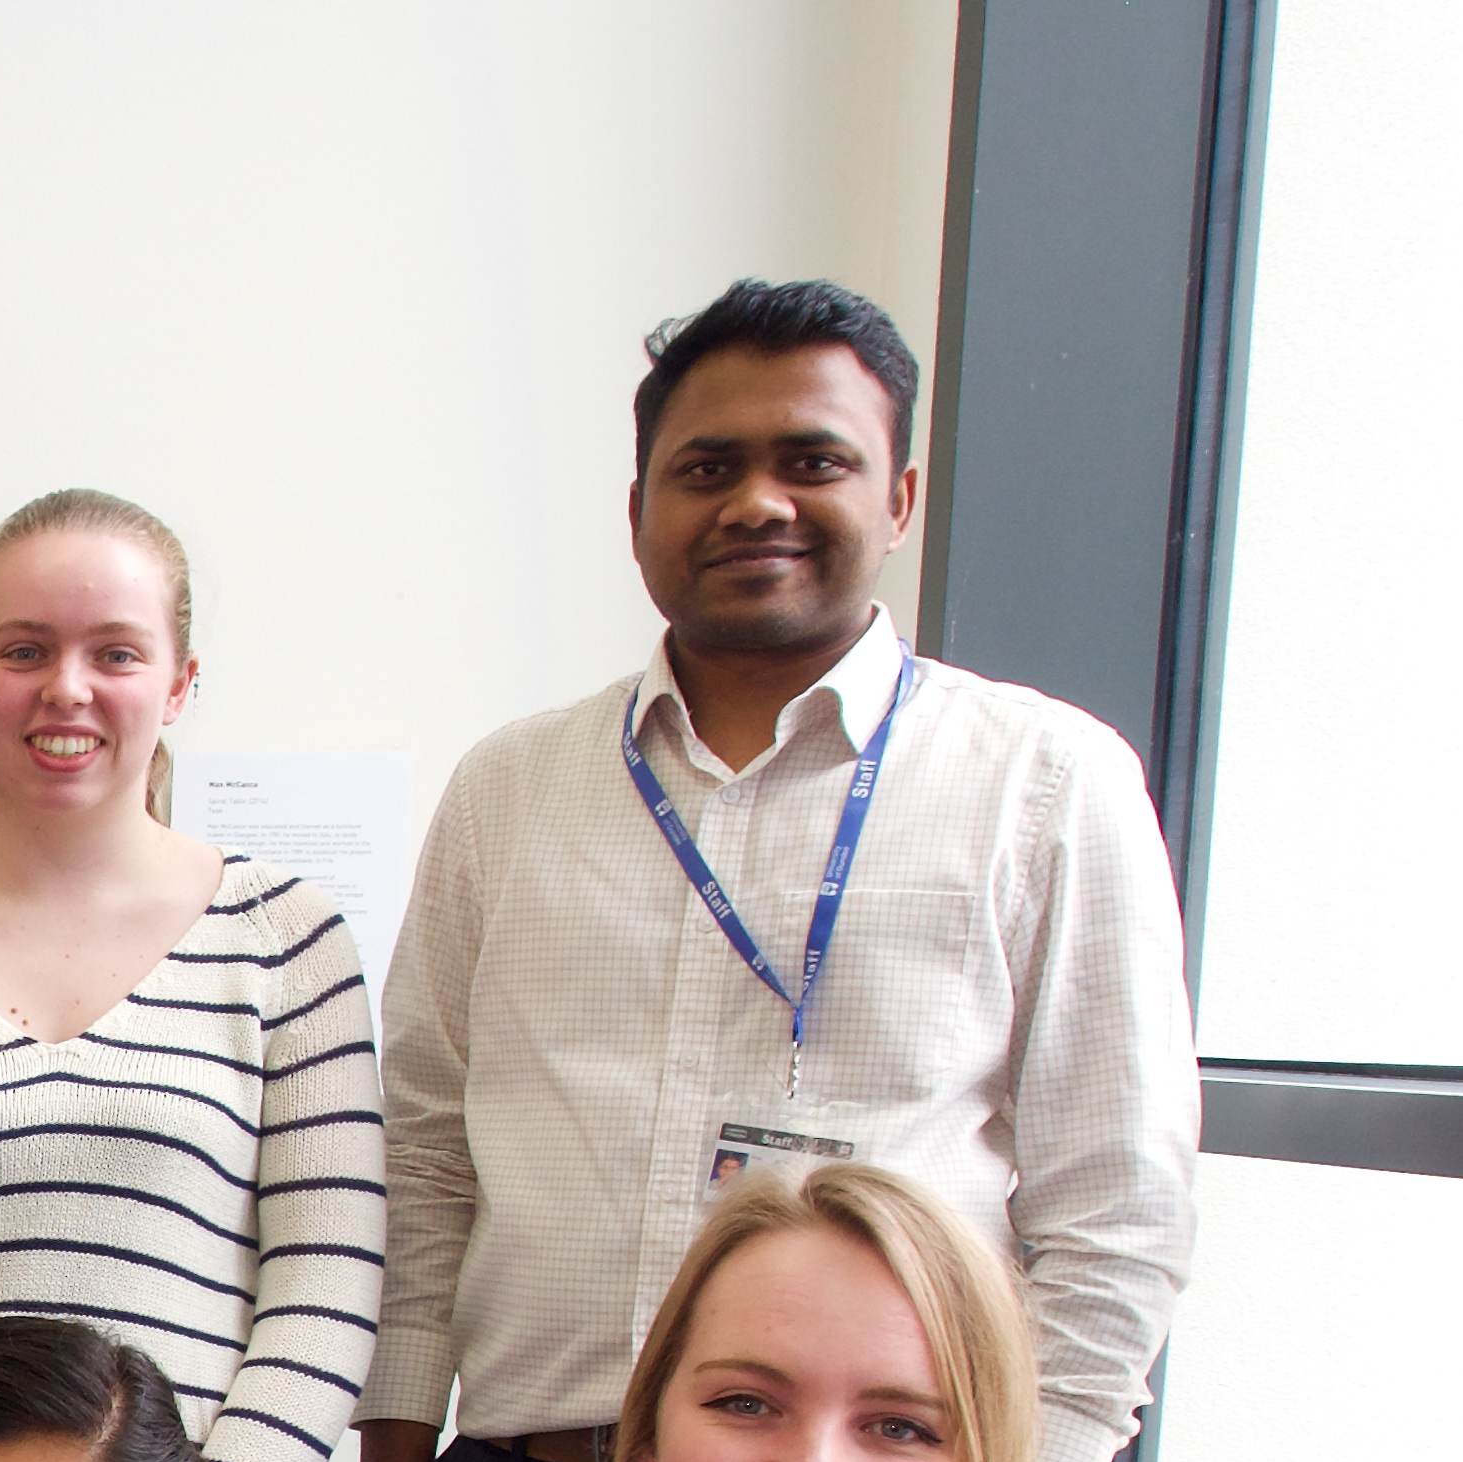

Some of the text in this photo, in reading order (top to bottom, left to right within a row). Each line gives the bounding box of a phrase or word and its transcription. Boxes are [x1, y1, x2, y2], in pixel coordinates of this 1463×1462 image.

[623, 731, 642, 767] Staff
[852, 760, 877, 799] Staff
[702, 881, 733, 919] Staff
[761, 1133, 793, 1149] Staff
